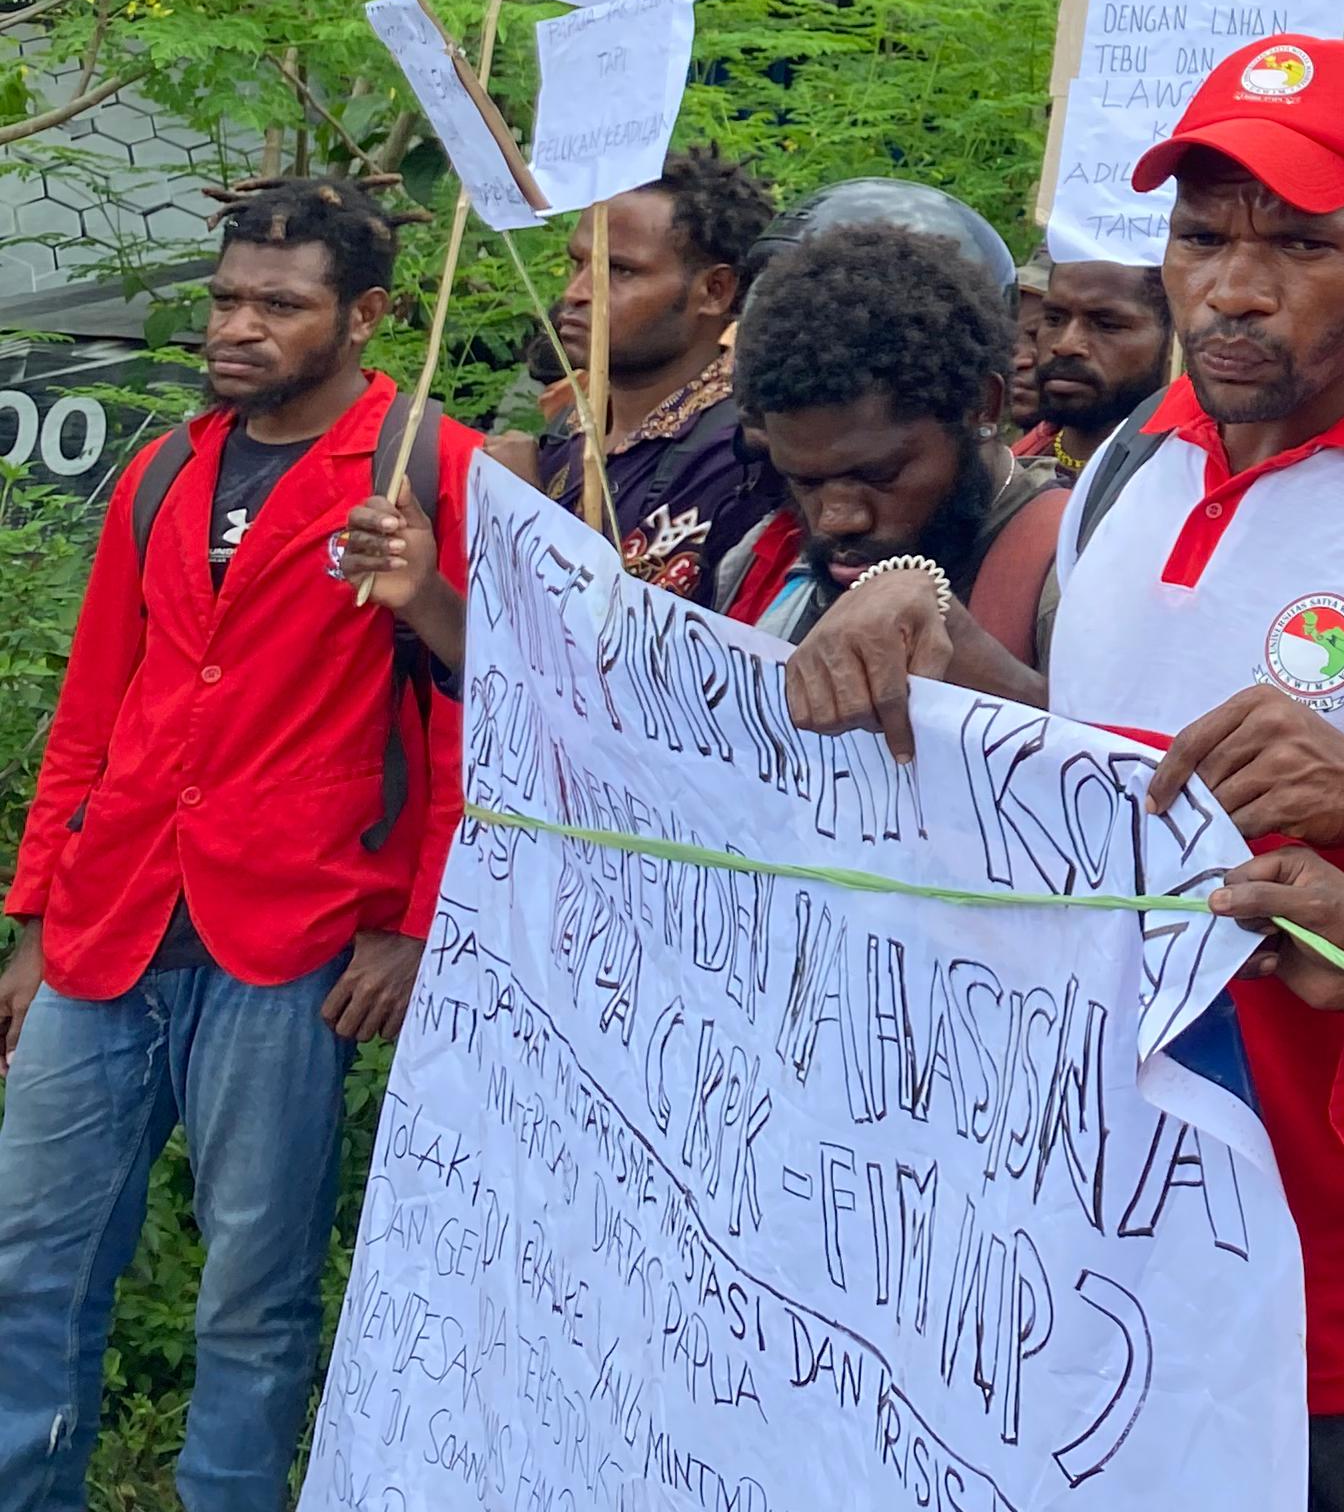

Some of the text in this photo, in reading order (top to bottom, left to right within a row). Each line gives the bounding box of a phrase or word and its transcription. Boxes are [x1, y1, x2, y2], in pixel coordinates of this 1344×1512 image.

[1103, 3, 1288, 36] DENGAN LAHAN
[1095, 44, 1149, 73] TEBU
[1176, 47, 1215, 73] DAN
[662, 1281, 768, 1424] PAPUA
[788, 1306, 865, 1408] DAN
